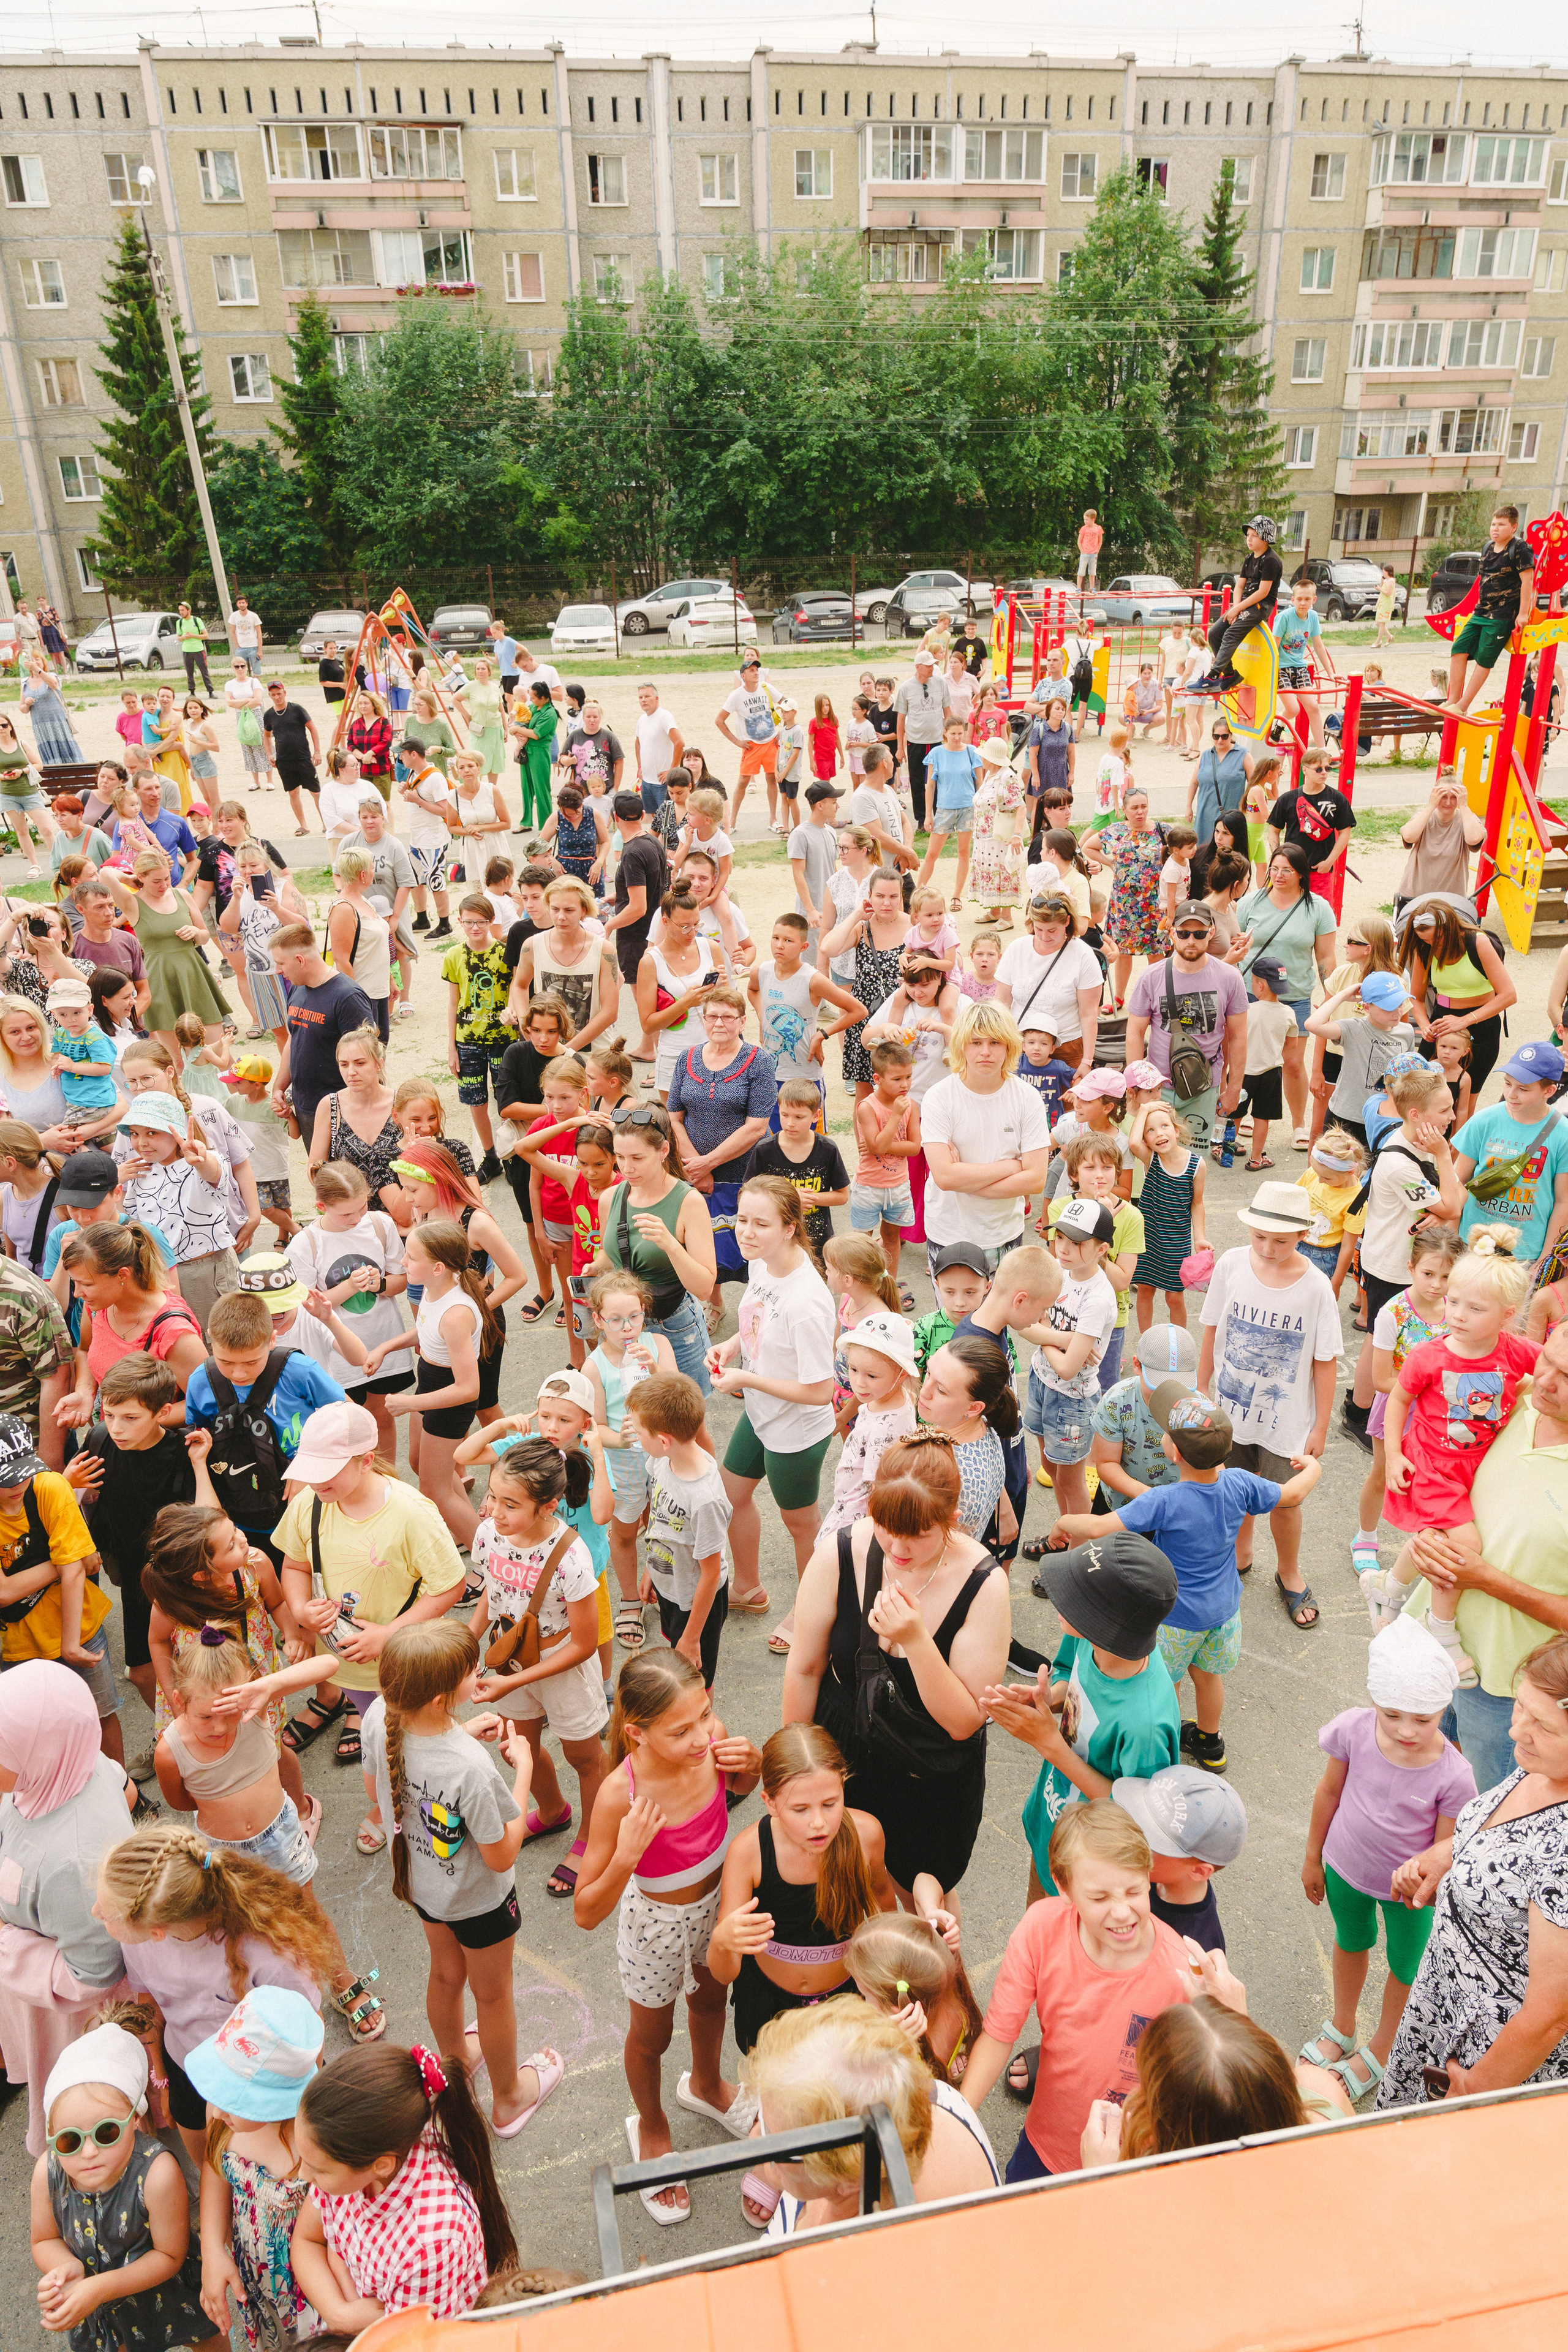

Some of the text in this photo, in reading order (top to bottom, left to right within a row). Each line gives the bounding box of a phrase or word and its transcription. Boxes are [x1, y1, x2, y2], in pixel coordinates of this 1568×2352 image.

[743, 695, 767, 708] HAWAII
[1317, 801, 1336, 817] TR
[239, 908, 271, 927] What
[768, 989, 784, 1000] SEA
[298, 1008, 326, 1025] COUTURE
[462, 1011, 500, 1022] Imposto
[763, 1031, 780, 1042] STER
[457, 1075, 484, 1088] UIPMENT
[1020, 1073, 1057, 1088] DON'T
[1041, 1089, 1057, 1100] ET
[1488, 1137, 1525, 1147] STREET
[1404, 1186, 1427, 1202] UP
[1233, 1301, 1302, 1332] RIVIERA
[1218, 1393, 1278, 1430] STYLE
[1145, 1463, 1167, 1475] COOL
[1545, 1489, 1563, 1512] Reebok
[554, 1506, 577, 1518] ND
[1082, 1542, 1103, 1573] Today
[493, 1558, 540, 1588] LOVE
[496, 1580, 533, 1598] FOREER
[29, 1589, 45, 1607] adidas
[1152, 1792, 1169, 1819] STATE
[1153, 1777, 1178, 1792] NEW
[1170, 1792, 1188, 1834] YORK
